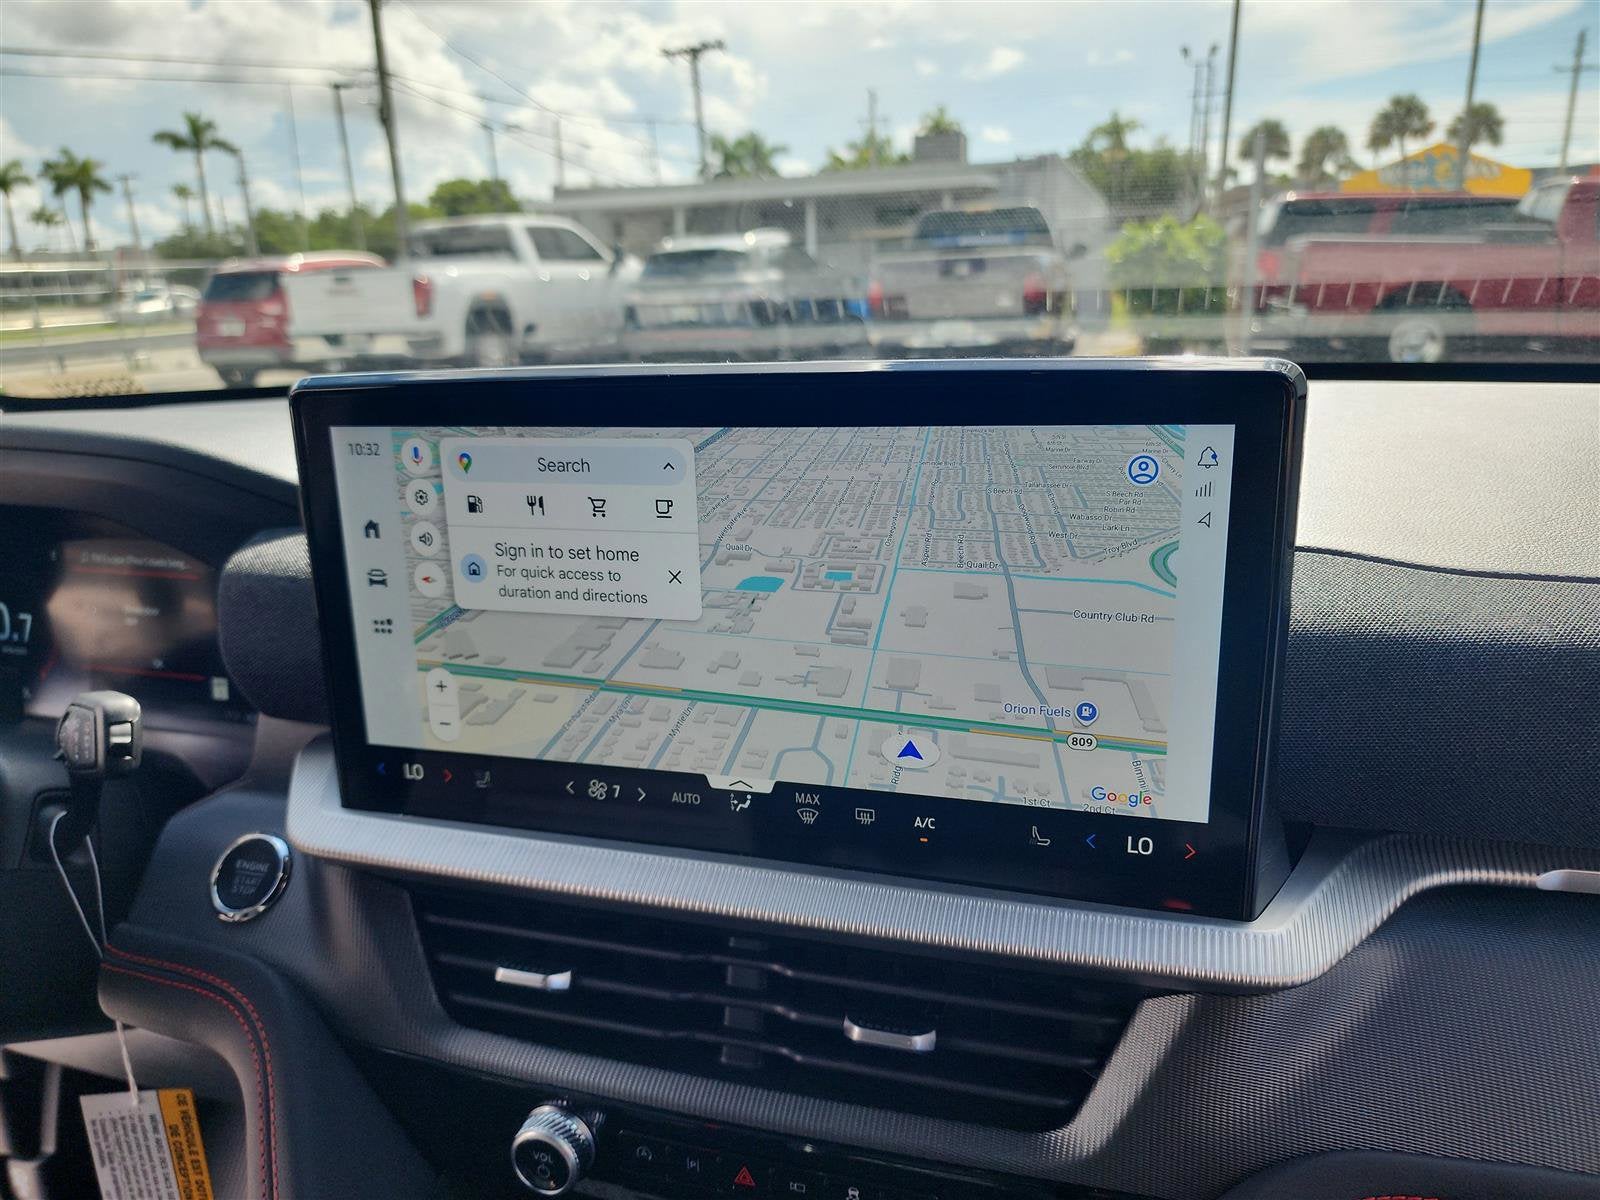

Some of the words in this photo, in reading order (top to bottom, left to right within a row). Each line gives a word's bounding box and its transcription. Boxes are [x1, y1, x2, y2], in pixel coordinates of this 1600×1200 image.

[348, 443, 380, 456] 10:32
[538, 457, 590, 472] Search
[717, 518, 737, 541] Westgate
[736, 507, 747, 519] Ave
[885, 521, 897, 546] Oswego
[924, 532, 932, 542] Rd
[958, 534, 965, 544] Rd
[1049, 531, 1067, 539] West
[494, 542, 526, 561] Sign
[531, 543, 543, 558] in
[549, 545, 564, 560] to
[568, 546, 591, 560] set
[597, 545, 639, 562] home
[726, 543, 744, 551] Quail
[745, 544, 753, 552] Dr
[1104, 545, 1120, 555] Troy
[1120, 539, 1138, 550] Blvd
[921, 542, 931, 567] Aspen
[957, 547, 965, 568] Beech
[966, 561, 987, 569] Quail
[496, 565, 517, 577] For
[521, 566, 554, 580] quick
[559, 569, 604, 581] access
[608, 570, 621, 582] to
[499, 585, 550, 599] duration
[555, 588, 578, 600] and
[583, 588, 648, 604] directions
[1073, 609, 1113, 622] Country
[1115, 612, 1138, 622] Club
[1141, 613, 1154, 623] Rd
[1004, 703, 1036, 715] Orion
[1039, 706, 1071, 717] Fuels
[668, 714, 686, 738] Myrtle
[682, 706, 693, 717] Ln
[1071, 737, 1093, 746] 809
[403, 763, 424, 780] LO
[890, 766, 903, 784] Ridg
[612, 785, 620, 798] 7
[672, 792, 701, 805] AUTO
[795, 792, 820, 805] MAX
[1091, 786, 1152, 807] Google
[1023, 797, 1038, 805] 1st
[1040, 798, 1051, 807] Ct
[1083, 803, 1102, 813] 2nd
[1105, 805, 1116, 814] Ct
[914, 816, 936, 829] A/C
[1127, 836, 1153, 855] LO
[235, 859, 269, 872] ENGINE
[532, 1150, 553, 1163] VOL
